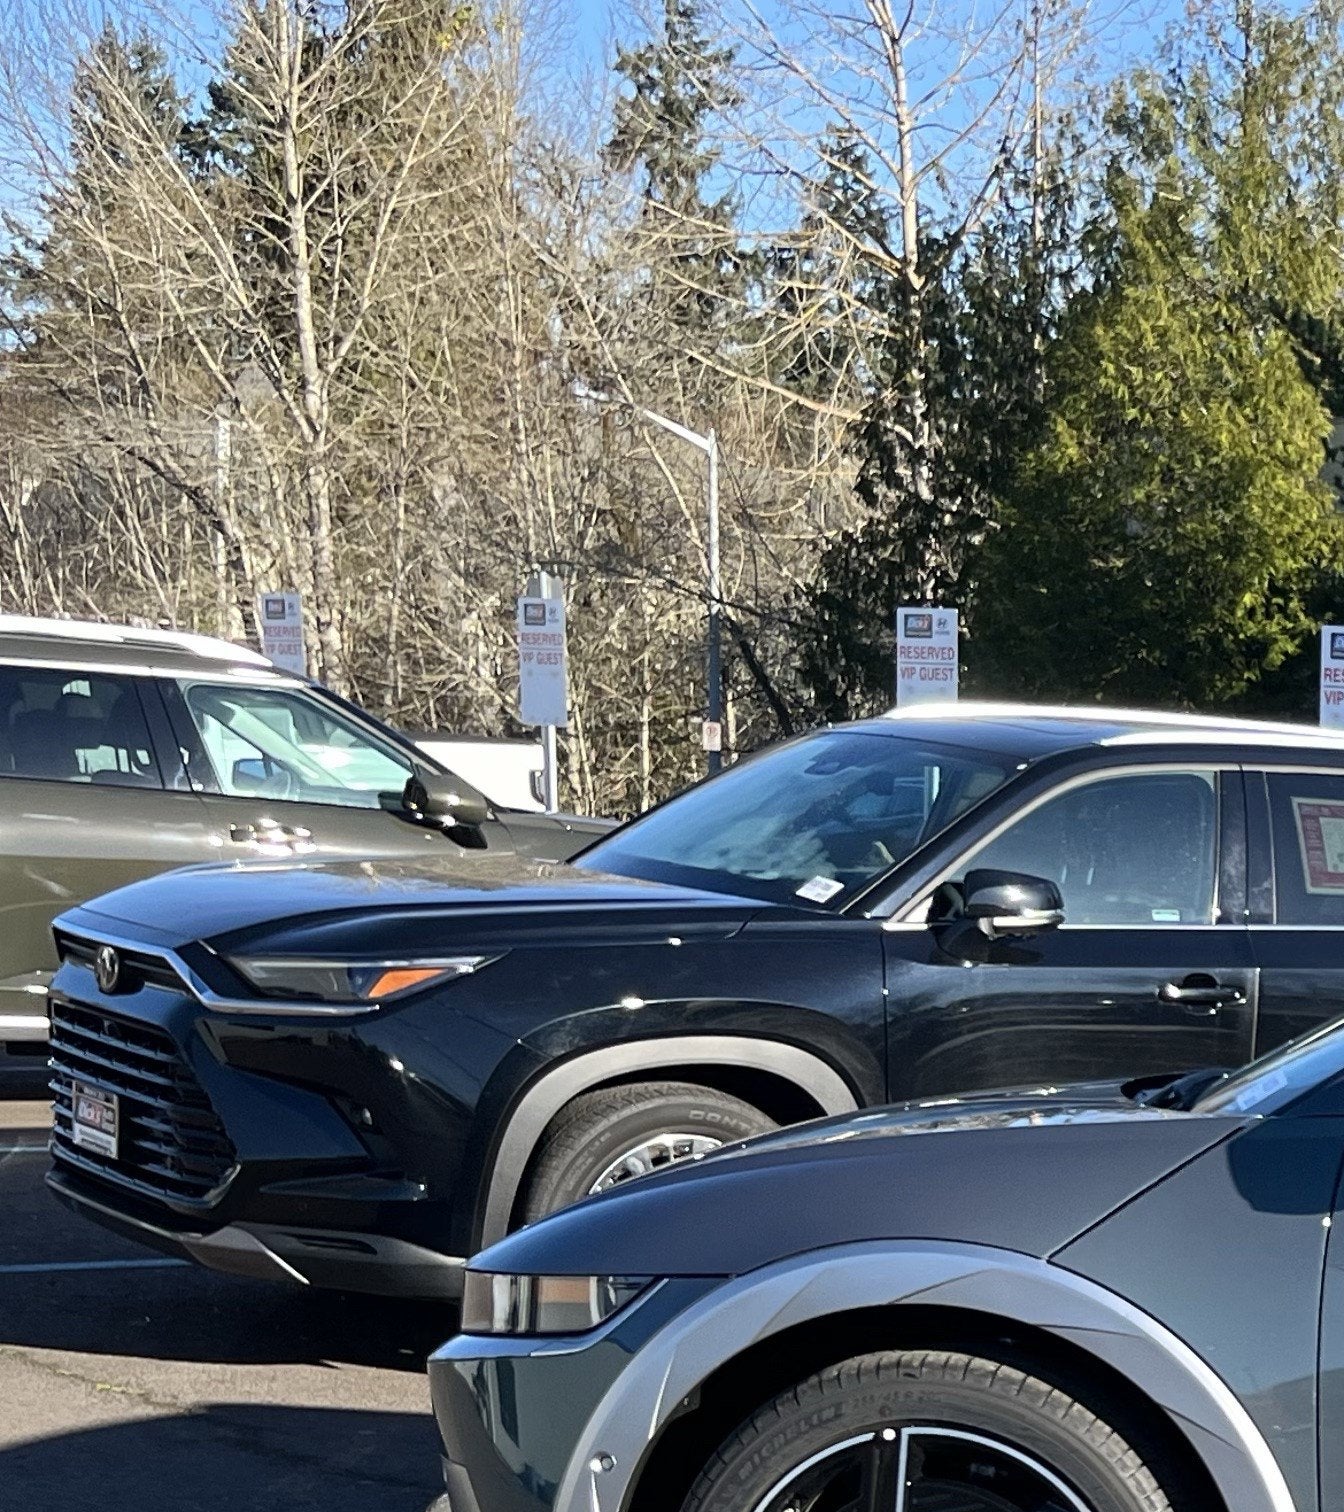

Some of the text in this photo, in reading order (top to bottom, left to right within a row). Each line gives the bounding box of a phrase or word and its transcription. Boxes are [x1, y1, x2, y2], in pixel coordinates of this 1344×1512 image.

[899, 645, 955, 661] RESERVED
[900, 666, 954, 682] VIP GUEST
[1324, 689, 1344, 705] VIP
